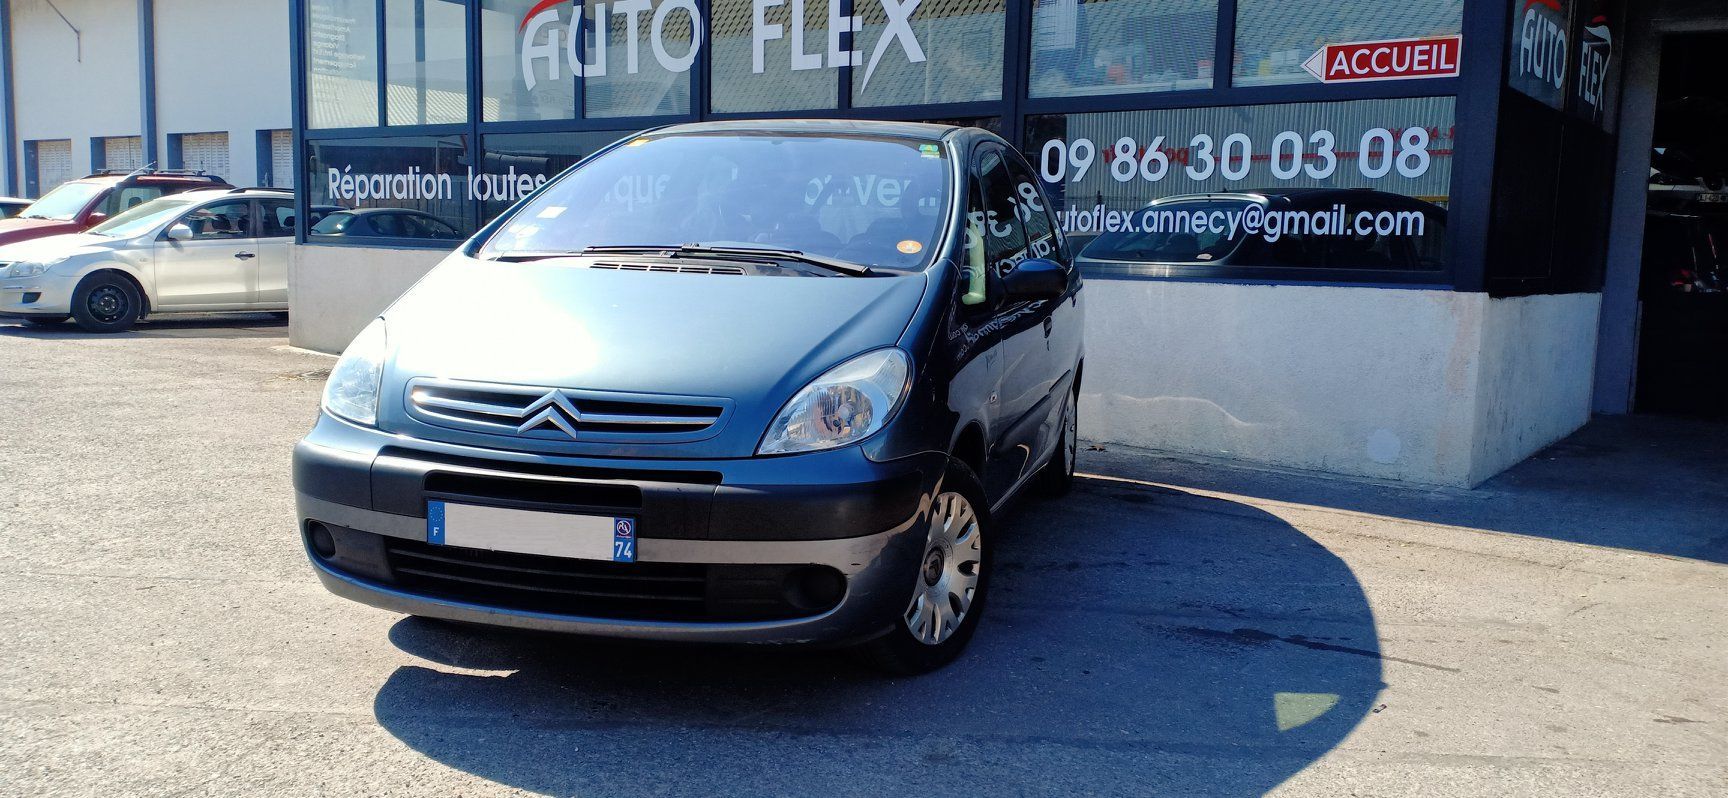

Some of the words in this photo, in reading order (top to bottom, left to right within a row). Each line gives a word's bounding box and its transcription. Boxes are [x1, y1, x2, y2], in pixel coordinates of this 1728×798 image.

[522, 0, 703, 91] AUTO
[752, 0, 926, 95] FLEX
[1329, 44, 1455, 76] ACCUEIL
[1520, 8, 1566, 89] AUTO
[1579, 25, 1611, 121] FLEX
[1041, 138, 1095, 184] 09
[1110, 136, 1169, 182] 86
[1186, 133, 1252, 181] 30
[1270, 130, 1337, 180] 03
[1359, 126, 1430, 179] 08
[328, 164, 452, 206] Réparation
[468, 165, 548, 201] toutes
[1056, 203, 1425, 243] utoflex.annecy@gmail.com
[433, 527, 440, 537] F
[615, 541, 633, 559] 74
